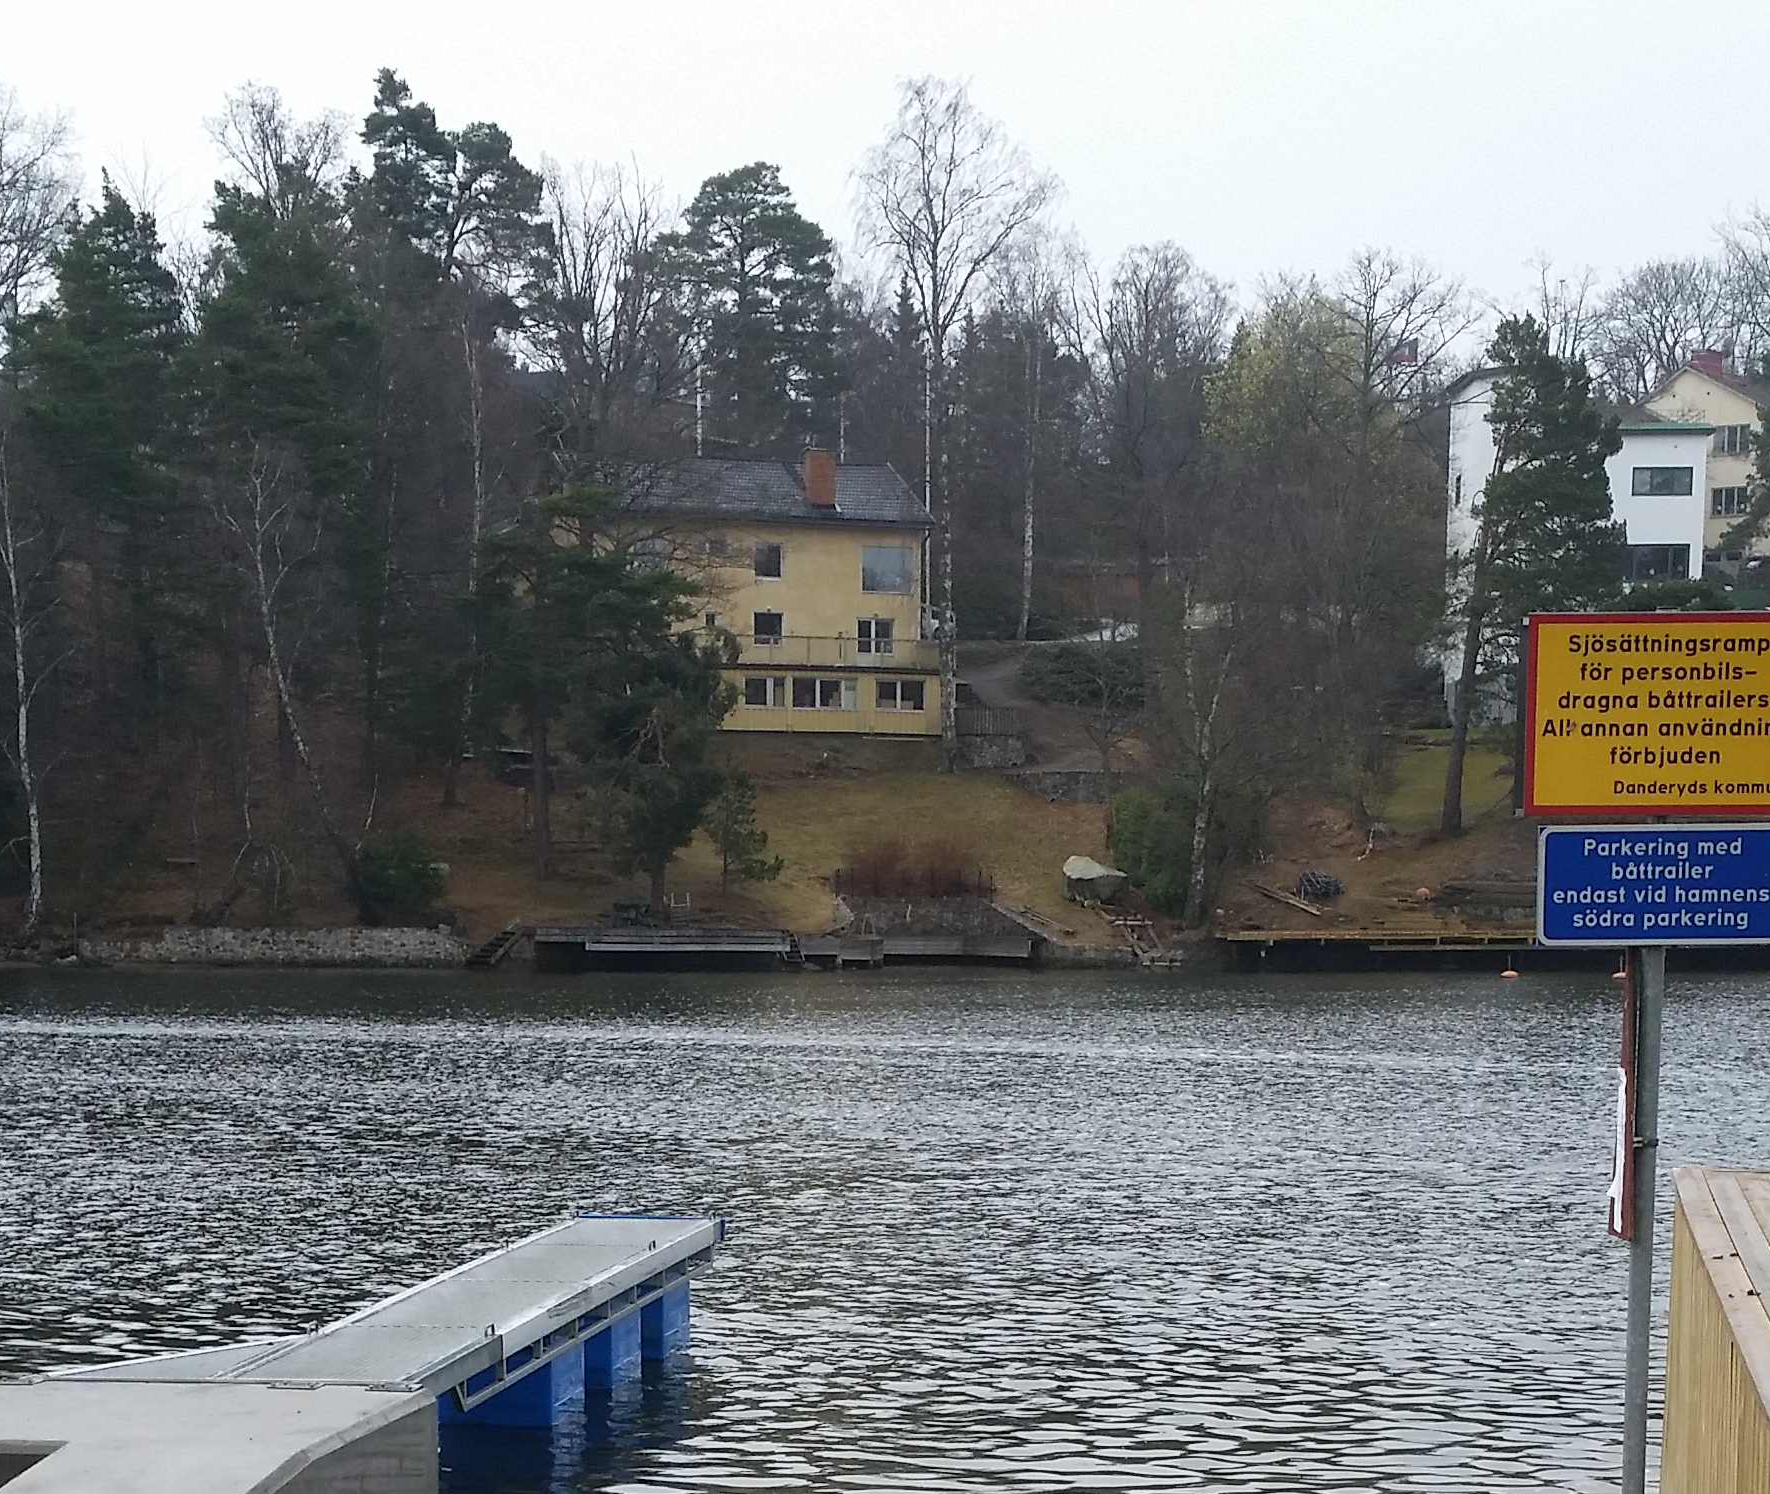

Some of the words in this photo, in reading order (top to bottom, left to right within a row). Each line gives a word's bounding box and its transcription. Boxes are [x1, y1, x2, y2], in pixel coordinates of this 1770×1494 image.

[1568, 633, 1770, 656] Sjösättningsramp
[1580, 661, 1613, 681] för
[1621, 661, 1758, 686] personbils-
[1558, 690, 1639, 714] dragna
[1580, 722, 1648, 737] annan
[1609, 745, 1721, 769] förbjuden
[1613, 780, 1708, 798] Danderyds
[1584, 837, 1689, 860] Parkering
[1697, 837, 1742, 855] med
[1611, 861, 1714, 880] båttrailer
[1553, 886, 1626, 904] endast
[1634, 884, 1666, 903] vid
[1675, 885, 1770, 903] hamnens
[1573, 908, 1635, 927] södra
[1643, 908, 1748, 931] parkering
